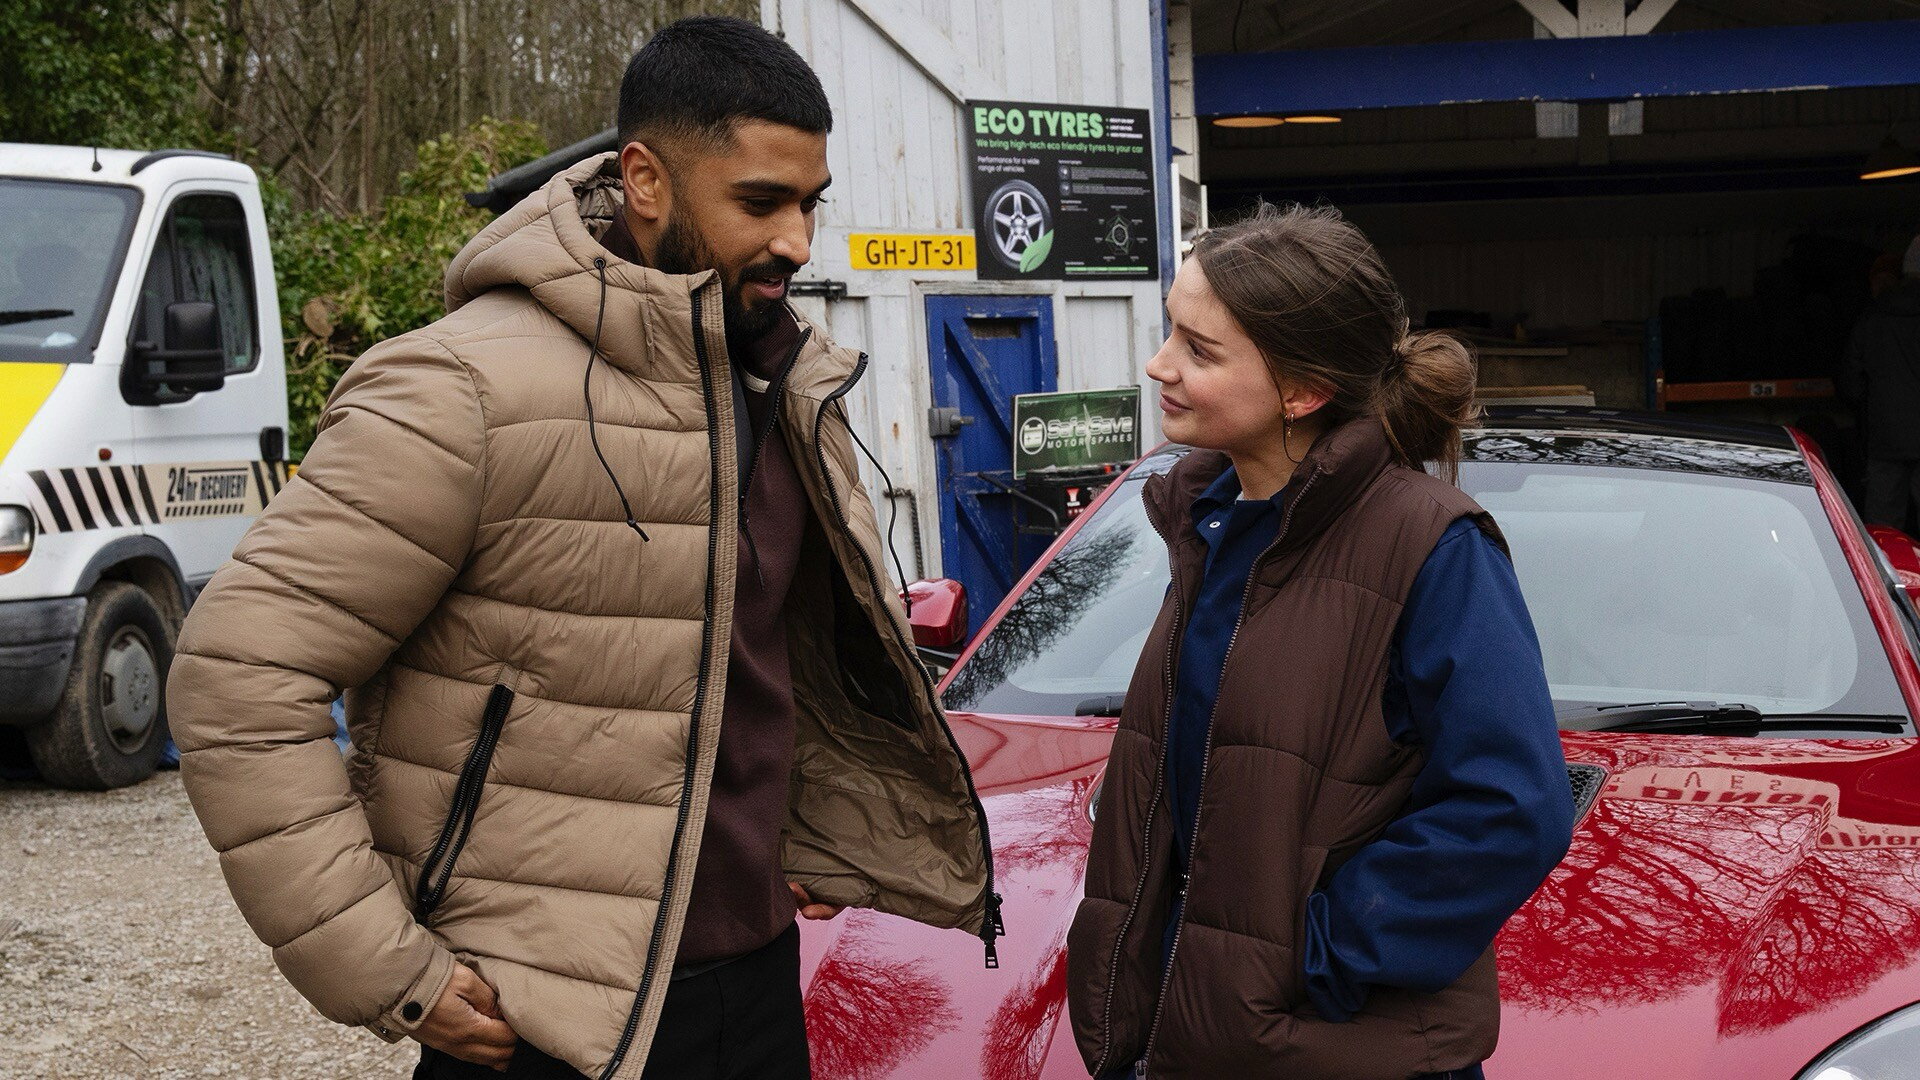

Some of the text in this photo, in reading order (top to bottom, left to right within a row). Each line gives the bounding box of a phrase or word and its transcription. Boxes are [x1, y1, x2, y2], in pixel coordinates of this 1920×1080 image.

[974, 107, 1104, 139] ECO TYRES
[976, 139, 1143, 155] We bring high-tech eco friendly tyres to your car
[977, 156, 1012, 164] Performance
[1012, 156, 1021, 164] for
[866, 239, 963, 265] GH-JT-31
[1047, 433, 1133, 449] MOTOR SPARES
[167, 467, 248, 502] 24hr RECOVERY
